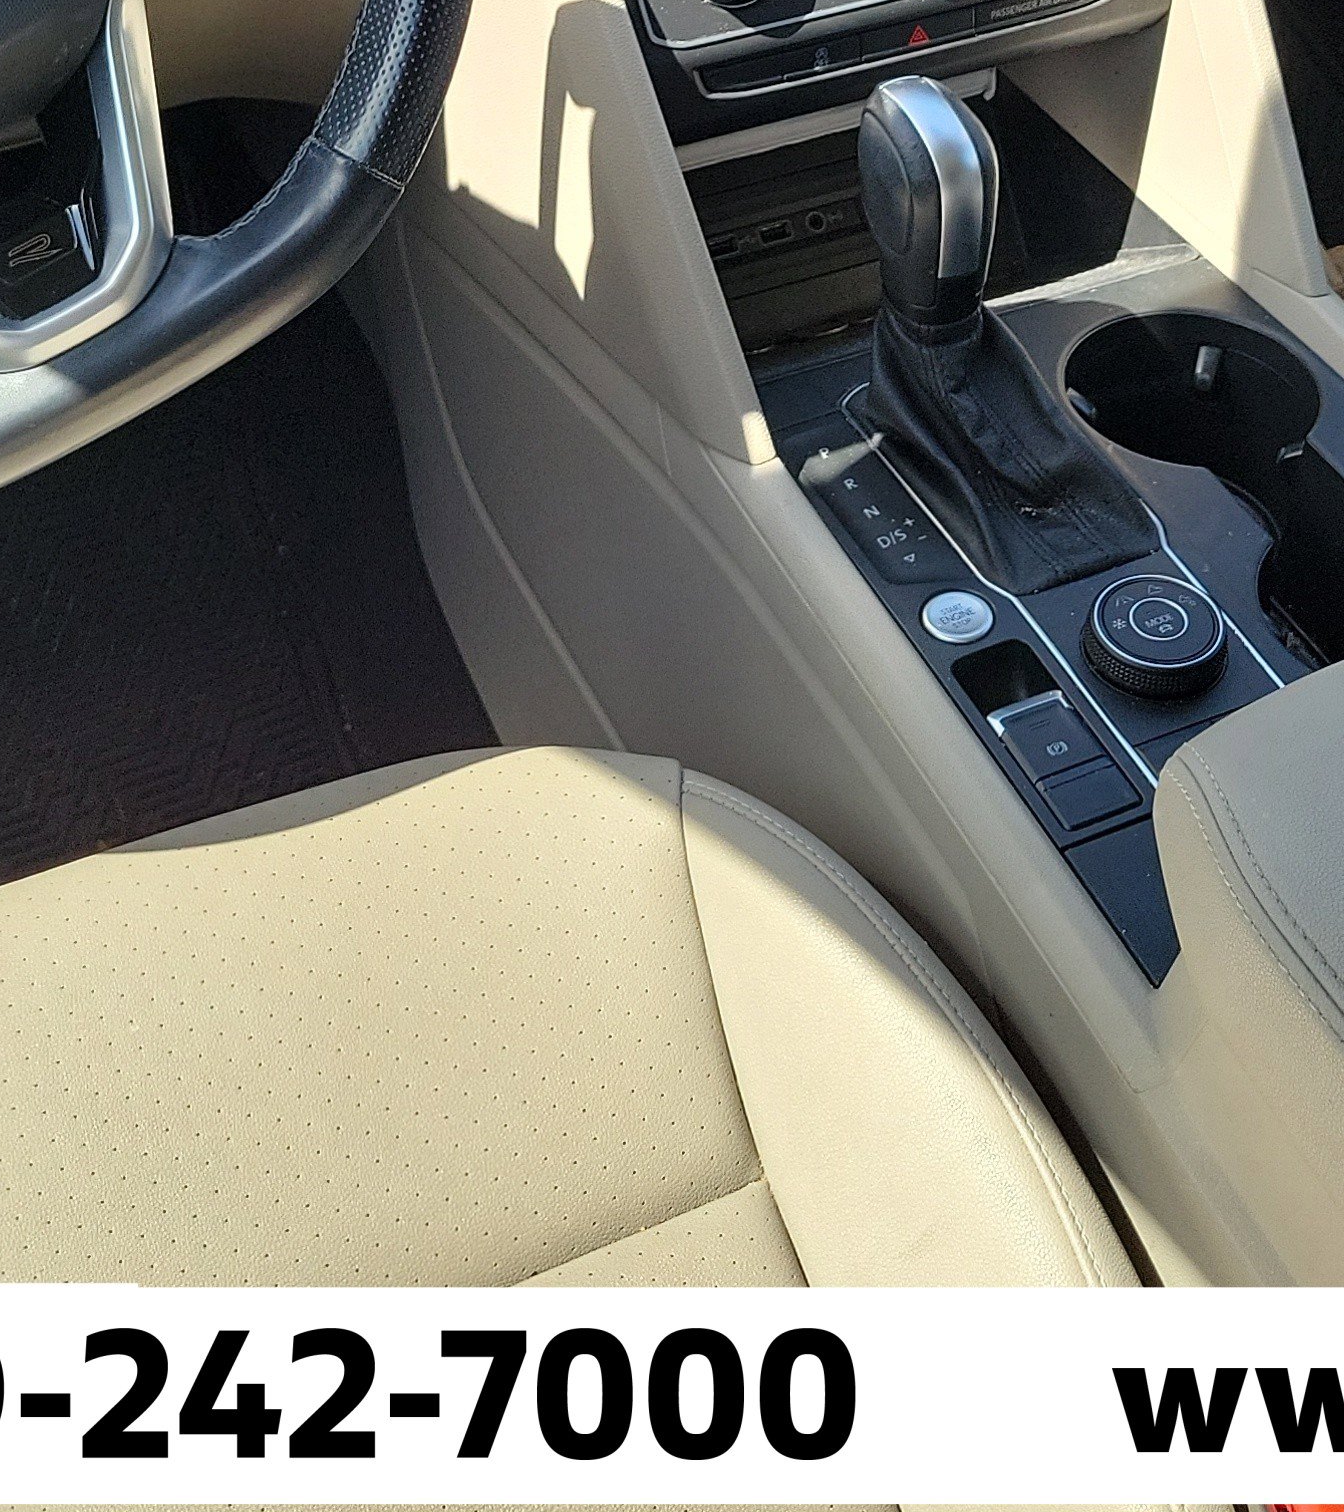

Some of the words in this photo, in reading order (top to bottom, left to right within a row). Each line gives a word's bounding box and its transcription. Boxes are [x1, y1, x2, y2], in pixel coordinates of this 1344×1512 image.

[990, 0, 1038, 20] PASSENGER
[843, 477, 859, 490] R
[863, 504, 881, 520] N
[876, 528, 907, 550] D/S
[939, 606, 976, 626] ENGINE
[940, 602, 964, 615] START
[952, 617, 972, 629] STOP
[1144, 612, 1174, 629] MODE
